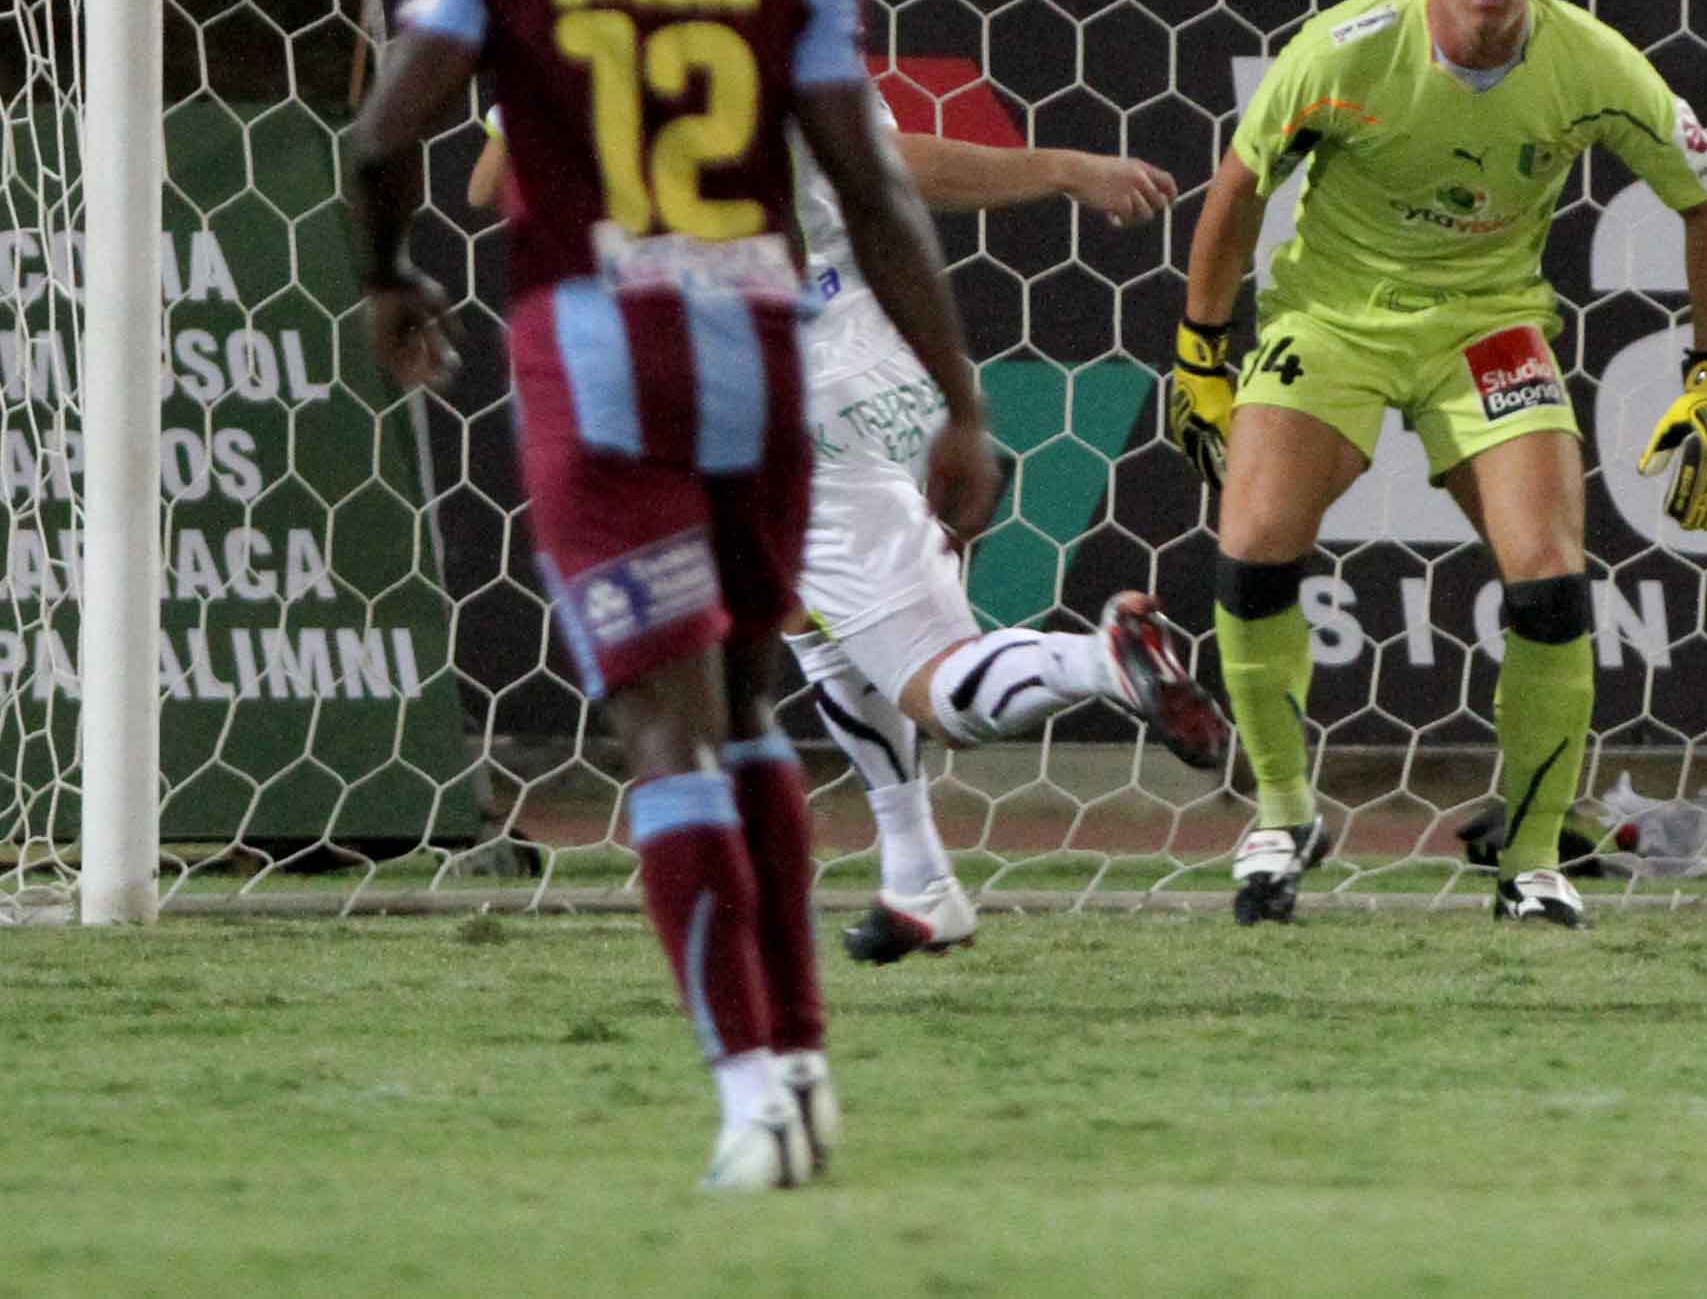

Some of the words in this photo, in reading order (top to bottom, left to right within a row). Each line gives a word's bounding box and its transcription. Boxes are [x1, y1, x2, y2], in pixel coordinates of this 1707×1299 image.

[556, 9, 768, 242] 12
[0, 229, 240, 301] COIA
[0, 329, 331, 403] MSOL
[3, 427, 262, 502] APOS
[0, 627, 423, 700] PAALIMNI
